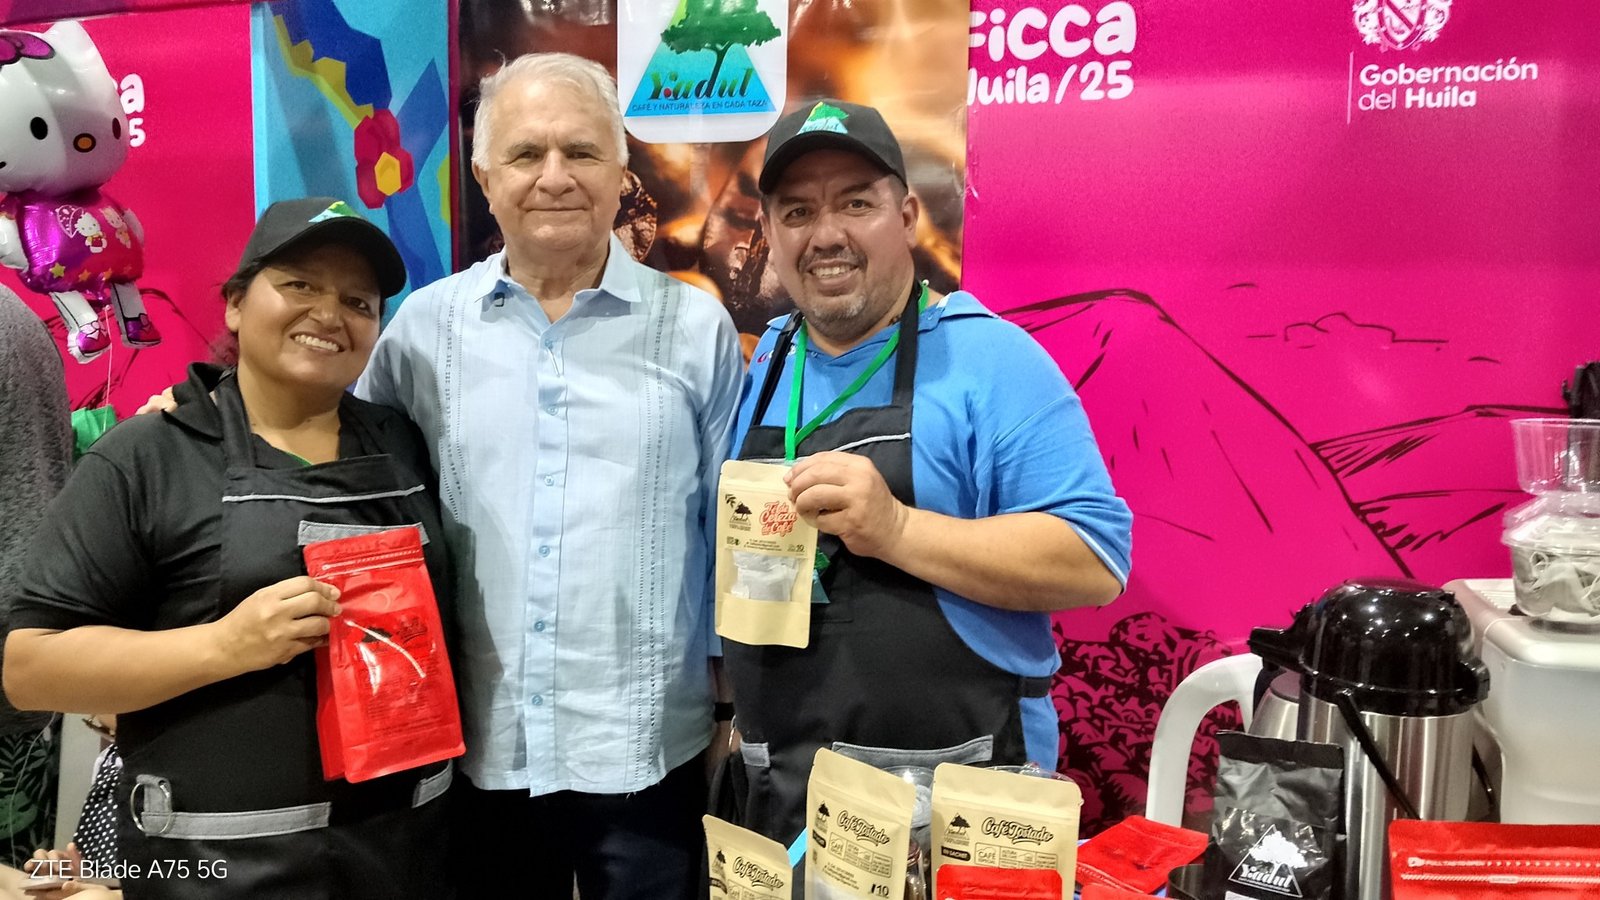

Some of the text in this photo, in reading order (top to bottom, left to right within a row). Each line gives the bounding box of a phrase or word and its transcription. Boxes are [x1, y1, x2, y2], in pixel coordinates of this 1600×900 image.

[1359, 56, 1538, 86] Gobernación
[632, 102, 652, 111] CAFÉ
[659, 102, 710, 111] NATURALEZA
[724, 101, 746, 109] CADA
[1358, 85, 1477, 111] del Huila
[837, 810, 857, 831] Café
[981, 817, 1054, 845] Café Tostado
